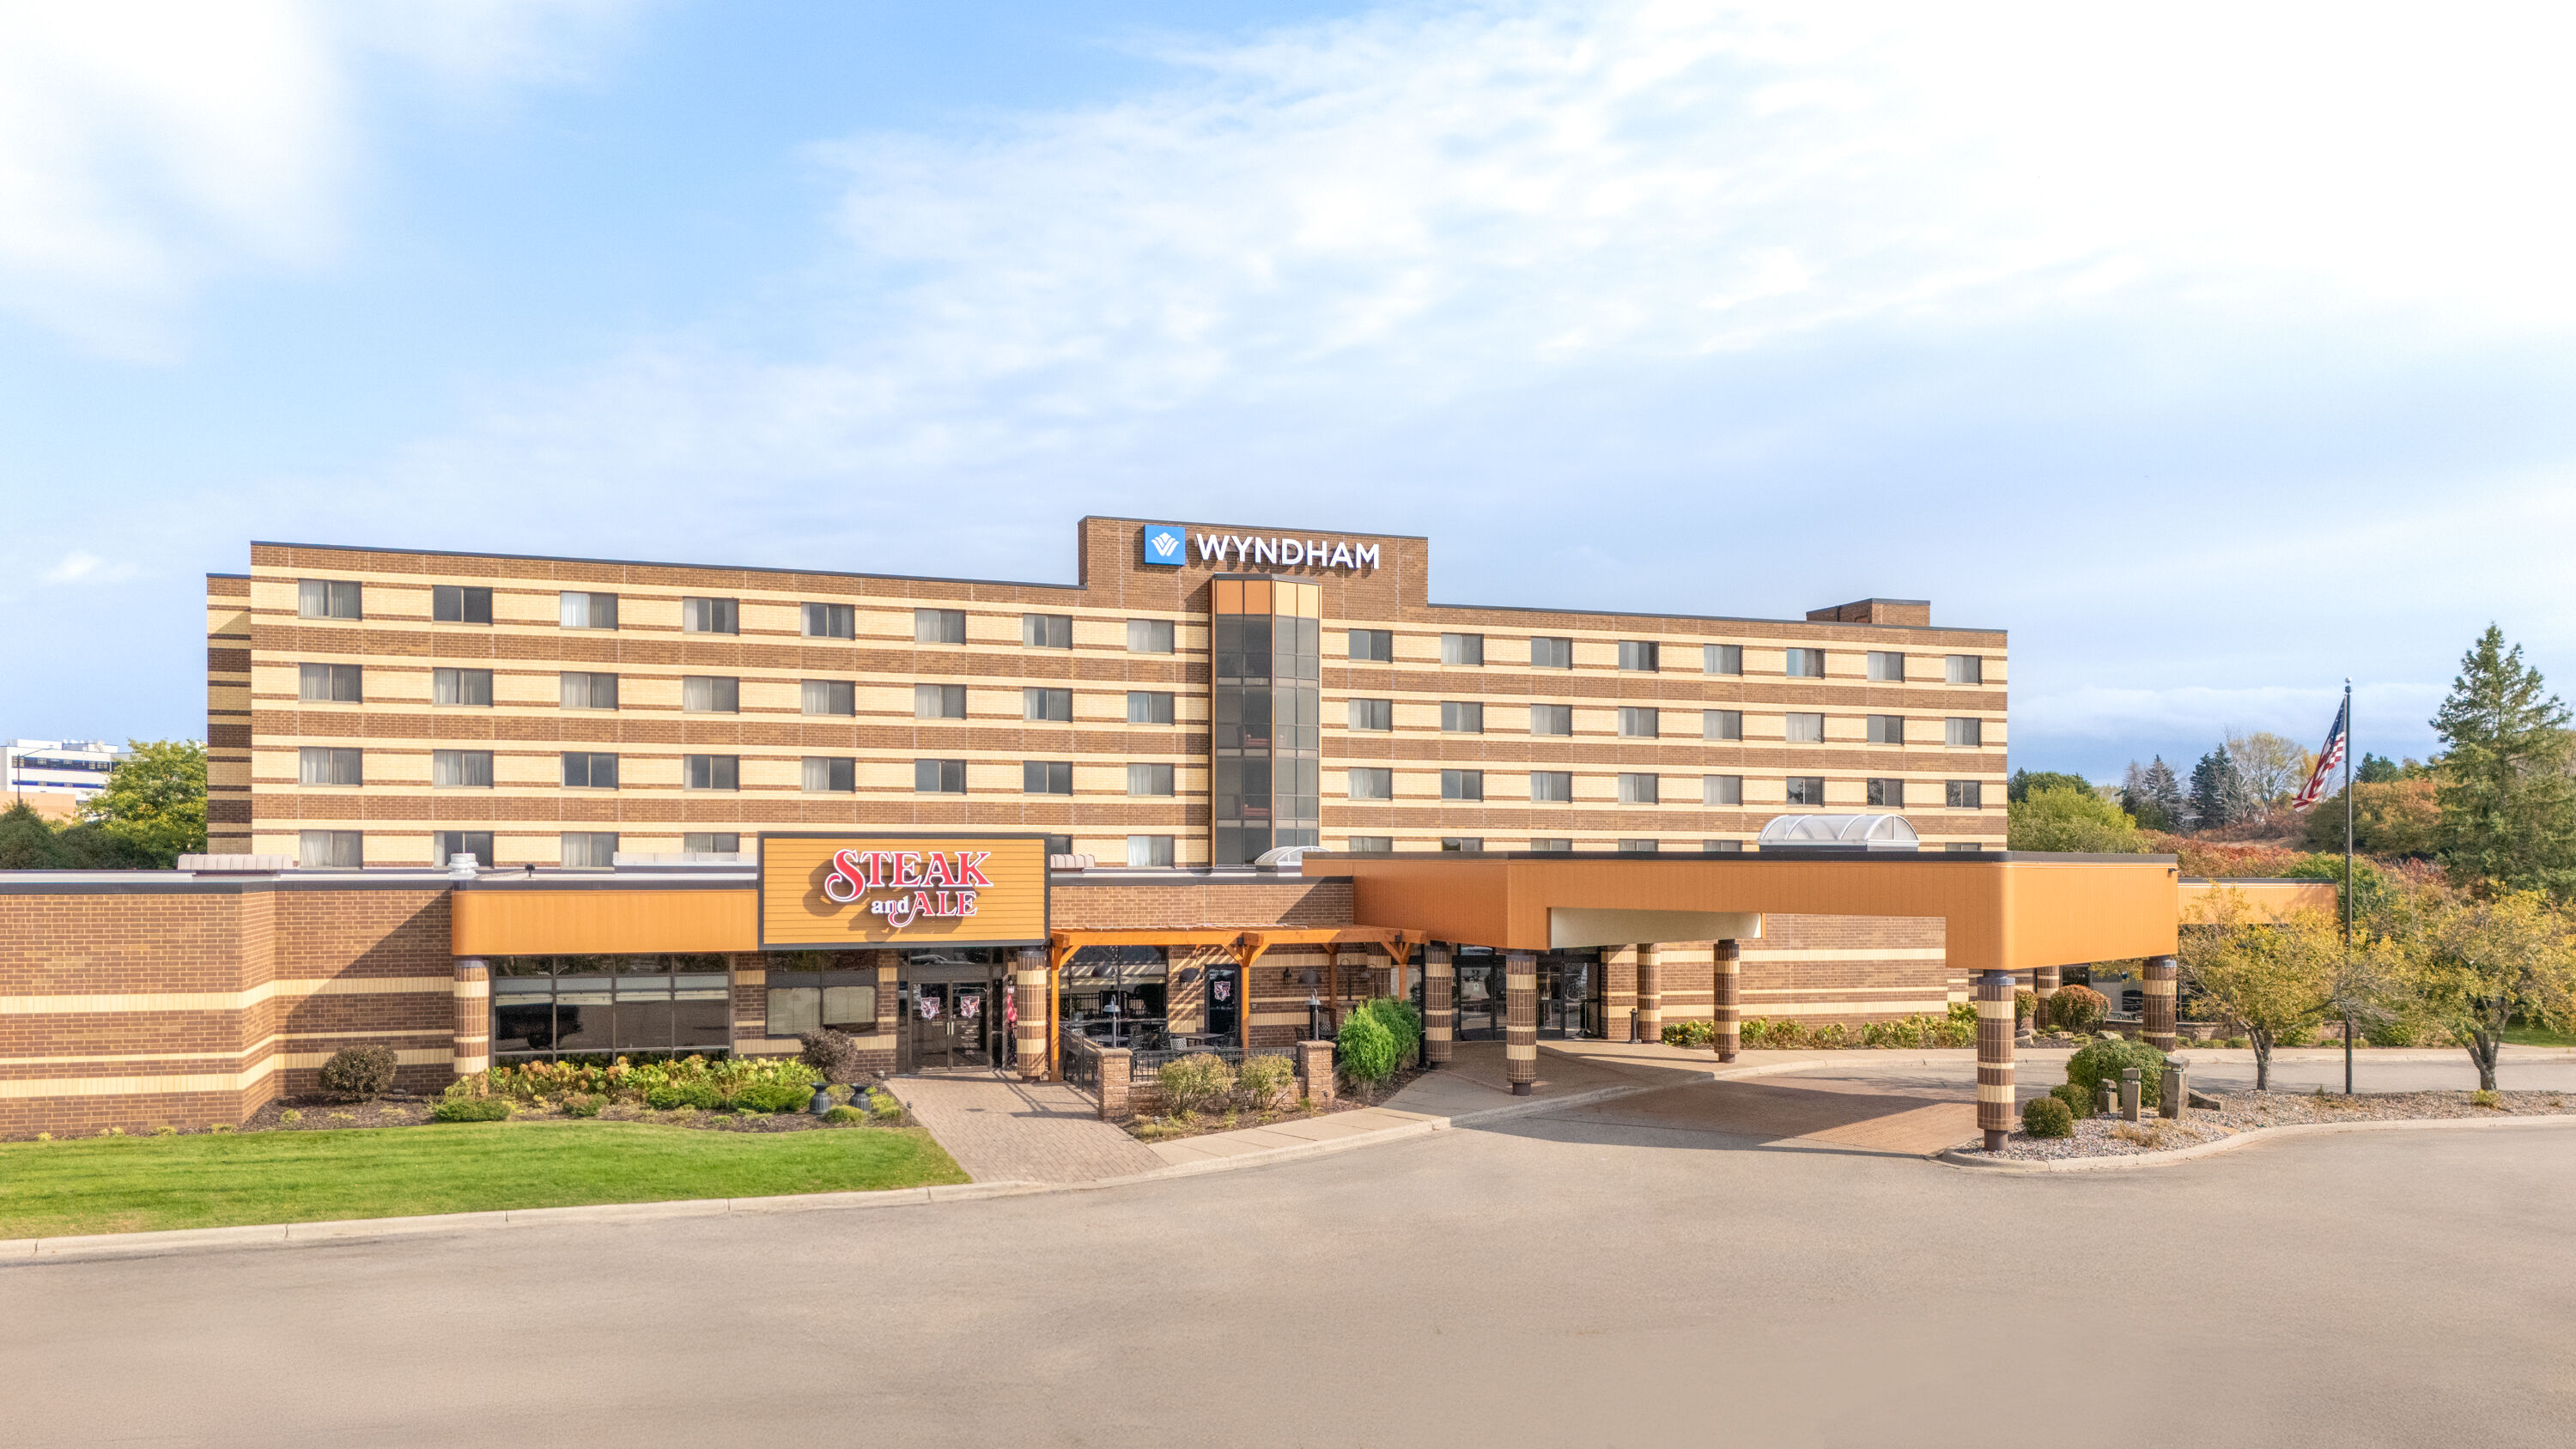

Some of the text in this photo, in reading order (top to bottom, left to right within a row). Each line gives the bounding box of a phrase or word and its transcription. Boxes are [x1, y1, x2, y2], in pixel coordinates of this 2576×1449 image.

[1196, 533, 1380, 569] WYNDHAM
[824, 848, 994, 902] STEAK
[871, 890, 978, 928] and ALE
